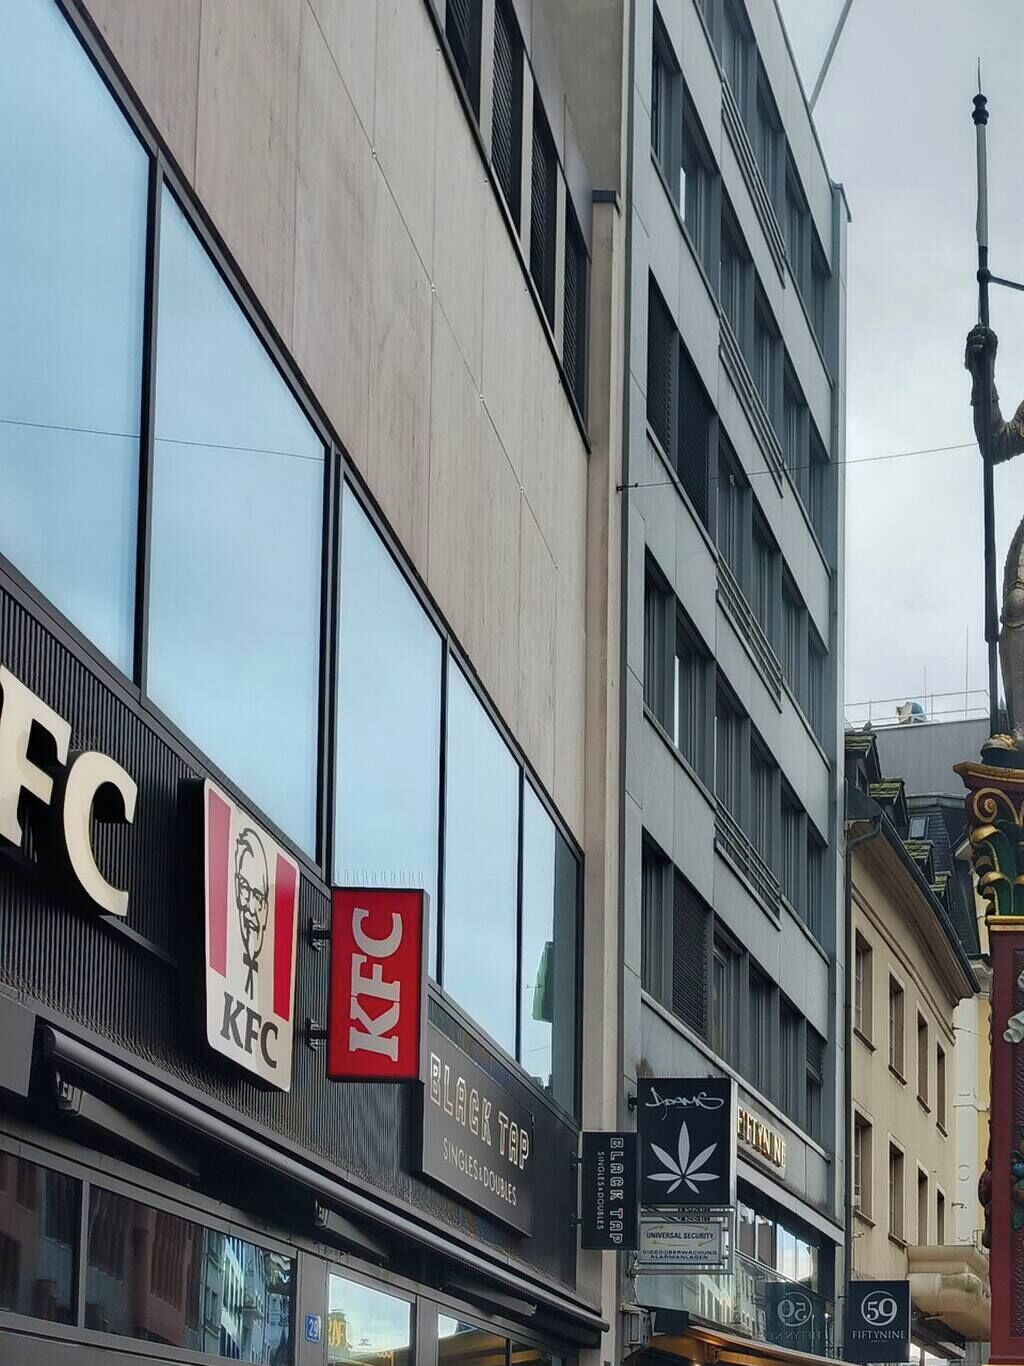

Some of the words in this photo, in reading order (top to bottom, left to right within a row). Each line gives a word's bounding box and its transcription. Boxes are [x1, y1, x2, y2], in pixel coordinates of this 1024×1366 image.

[0, 664, 138, 916] FC
[349, 907, 403, 1062] KFC
[220, 990, 279, 1069] KFC
[430, 1052, 492, 1146] BLACK
[498, 1111, 530, 1170] TAP
[737, 1105, 787, 1168] FIFTYNINE
[609, 1137, 624, 1201] BLACK
[609, 1207, 624, 1244] TAP
[646, 1231, 682, 1240] UNIVERSAL
[683, 1231, 714, 1240] SECURITY
[308, 1319, 319, 1338] 29
[852, 1329, 906, 1340] FIFTYNINE
[862, 1294, 898, 1326] 59
